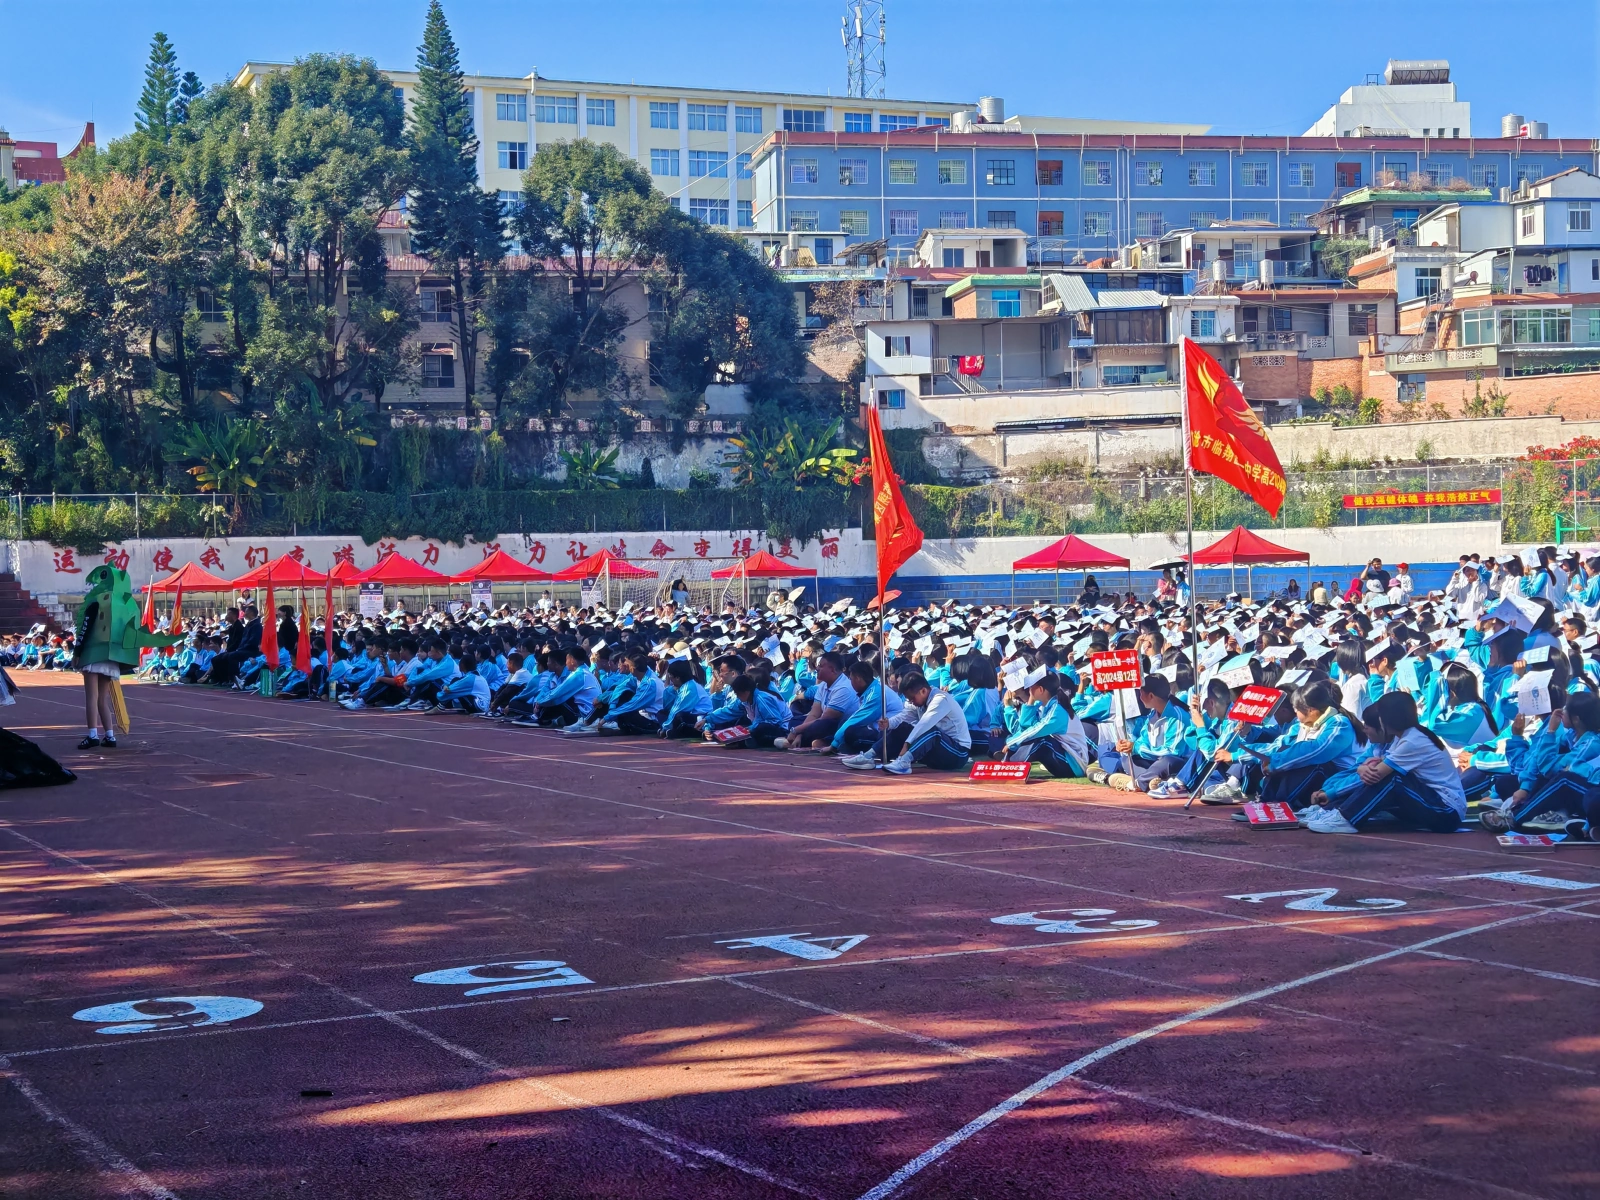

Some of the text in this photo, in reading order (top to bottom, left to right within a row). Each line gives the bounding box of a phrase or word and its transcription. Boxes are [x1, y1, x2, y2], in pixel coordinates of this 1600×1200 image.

[1096, 669, 1138, 684] 高2024级12班
[1223, 887, 1407, 911] 2
[990, 908, 1160, 933] 3
[713, 932, 870, 961] 4
[413, 960, 595, 997] 5
